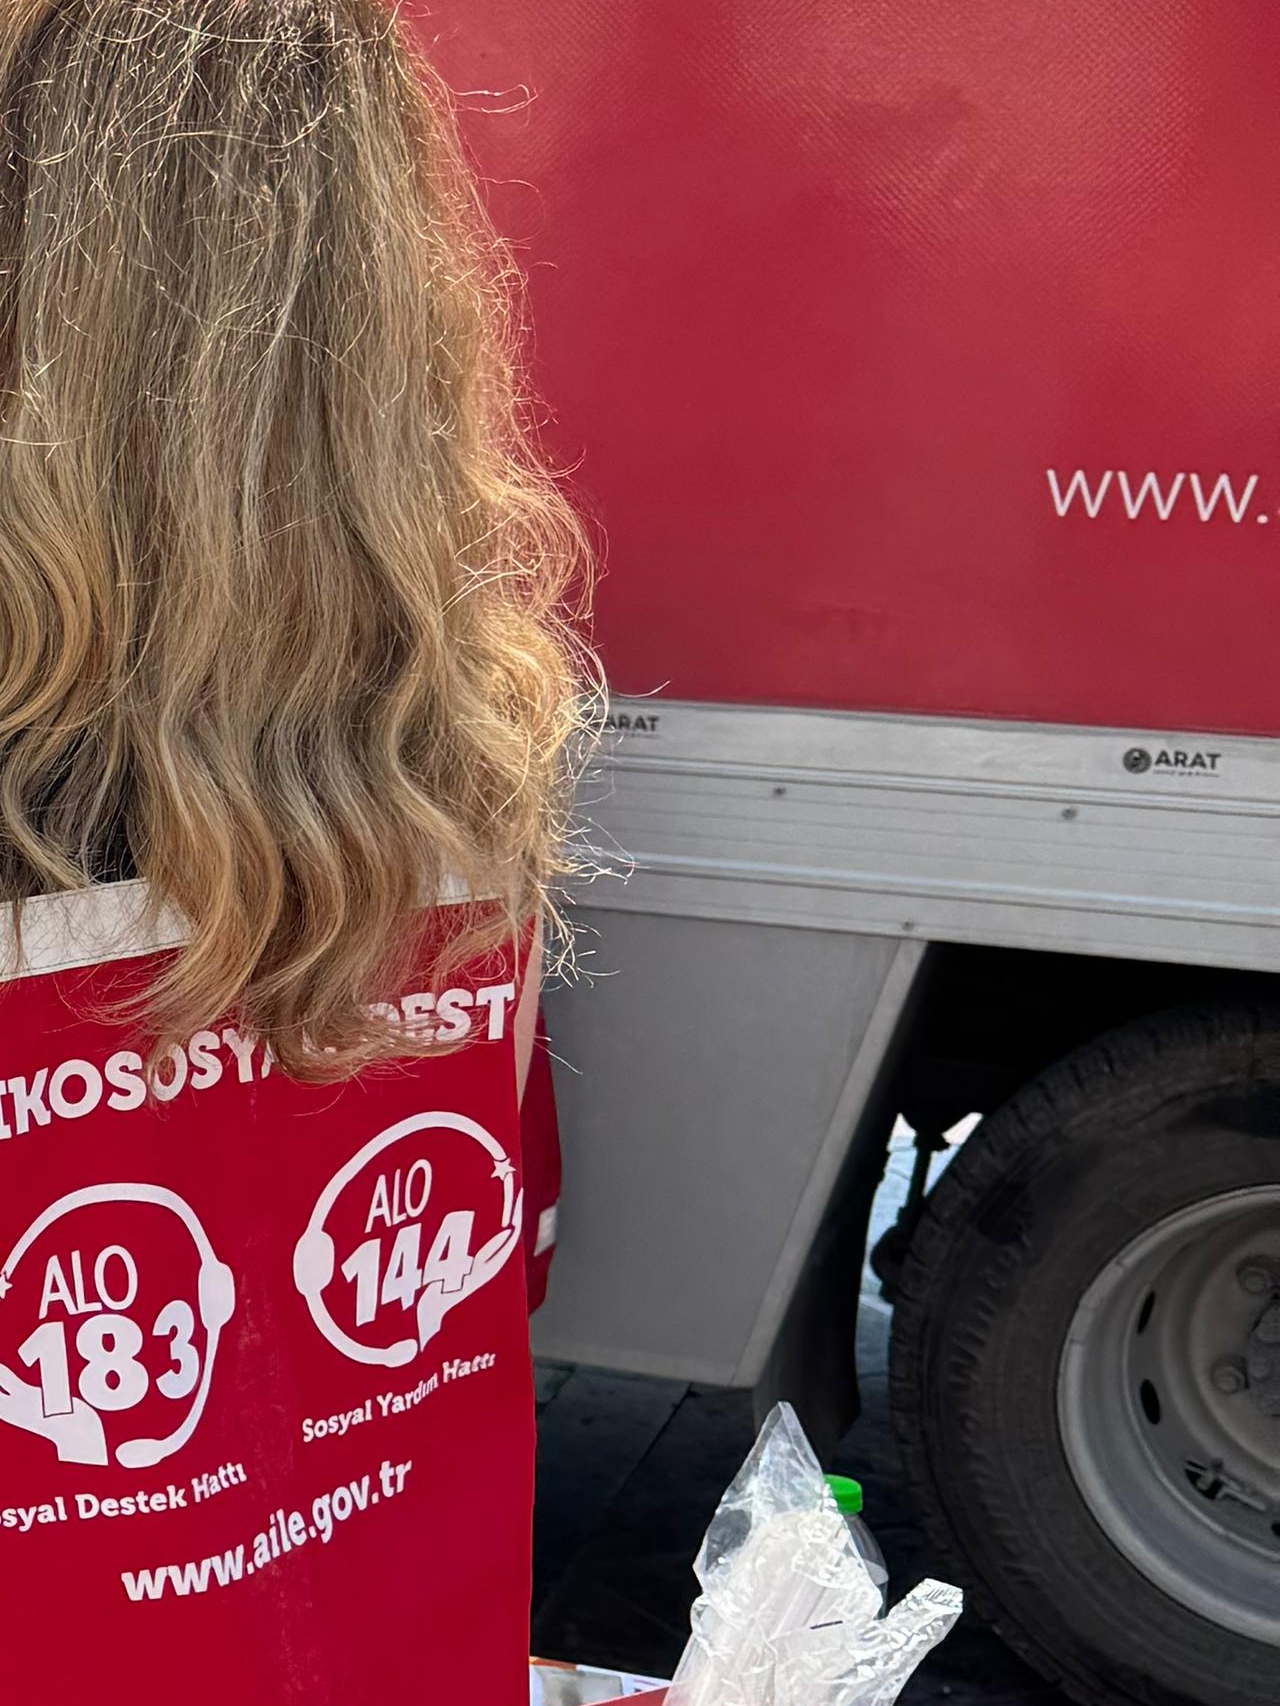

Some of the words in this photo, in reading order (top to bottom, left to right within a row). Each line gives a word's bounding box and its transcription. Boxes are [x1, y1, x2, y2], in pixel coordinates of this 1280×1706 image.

[1047, 469, 1280, 524] www.
[605, 714, 659, 732] ARAT
[1155, 749, 1221, 770] ARAT
[364, 1159, 433, 1233] ALO
[39, 1245, 139, 1320] ALO
[341, 1210, 475, 1327] 144
[17, 1300, 200, 1418] 183
[302, 1399, 373, 1443] Sosyal
[376, 1372, 439, 1418] Yardım
[442, 1352, 496, 1385] Hattı
[75, 1485, 188, 1520] Destek
[191, 1462, 248, 1504] Hattı
[121, 1459, 412, 1602] www.aile.gov.tr
